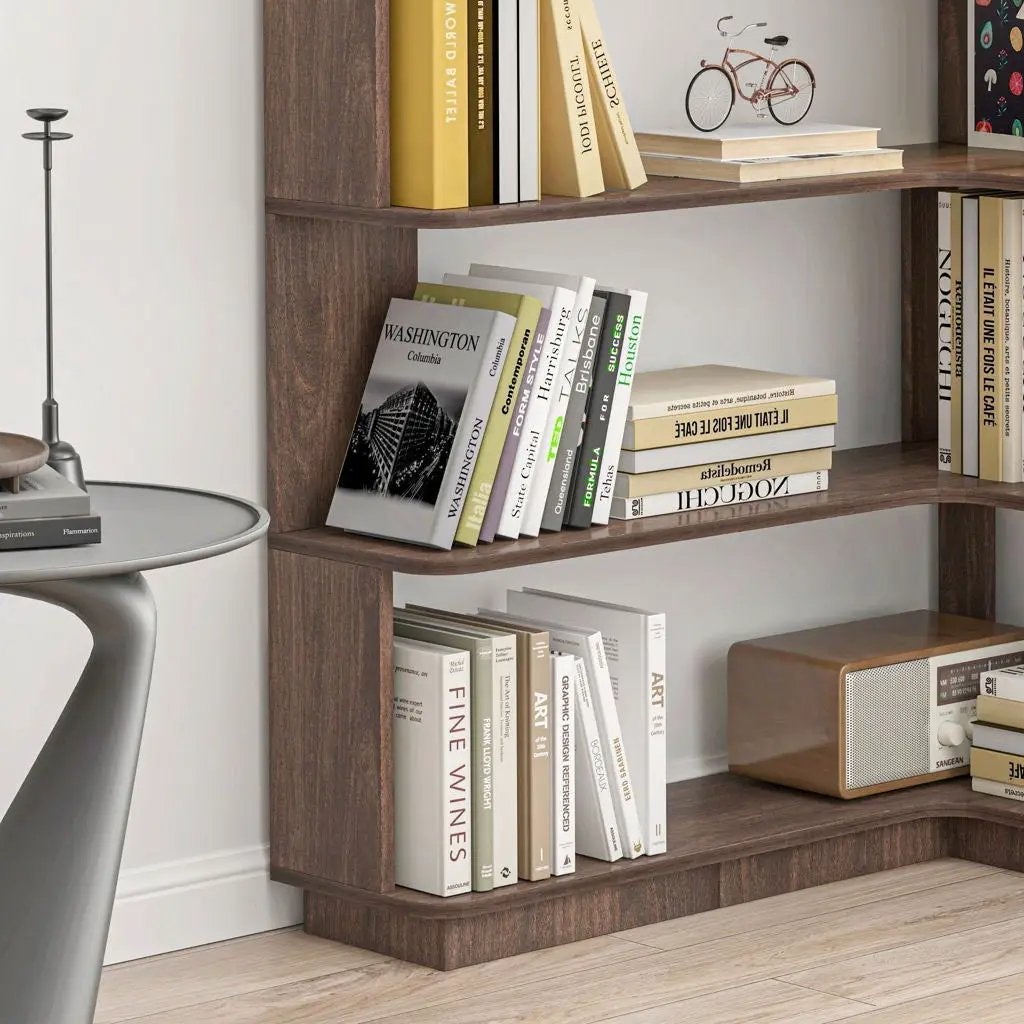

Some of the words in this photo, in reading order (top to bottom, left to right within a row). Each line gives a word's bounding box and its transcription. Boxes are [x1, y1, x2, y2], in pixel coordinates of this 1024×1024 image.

[983, 267, 995, 278] IL
[983, 282, 997, 317] ÉTAIT
[384, 323, 480, 352] WASHINGTON
[938, 247, 952, 402] NOGUCHI
[983, 319, 995, 345] UNE
[407, 350, 442, 365] Columbia
[983, 347, 995, 375] FOIS
[513, 389, 531, 436] FORM
[527, 333, 545, 385] STYLE
[983, 377, 995, 393] LE
[511, 483, 527, 518] State
[521, 430, 540, 479] Capital
[537, 307, 571, 400] Harrisburg
[555, 449, 574, 515] Queensland
[576, 314, 601, 394] Brisbane
[583, 447, 601, 507] FORMULA
[600, 394, 610, 421] FOR
[607, 314, 625, 372] SUCCESS
[599, 464, 614, 501] Tehas
[617, 314, 642, 386] Houston
[983, 396, 997, 427] CAFÉ
[447, 418, 484, 518] WASHINGTON
[488, 337, 506, 377] Columbia
[465, 482, 491, 530] Italia
[501, 328, 531, 415] Contemporan
[547, 416, 563, 463] TED
[63, 528, 98, 536] Flammarion
[651, 672, 664, 708] ART
[449, 686, 466, 752] FINE
[534, 692, 548, 728] ART
[613, 737, 627, 779] SAARINEN
[936, 757, 964, 768] SANGEAN
[622, 780, 631, 802] EERO
[449, 764, 467, 862] WINES
